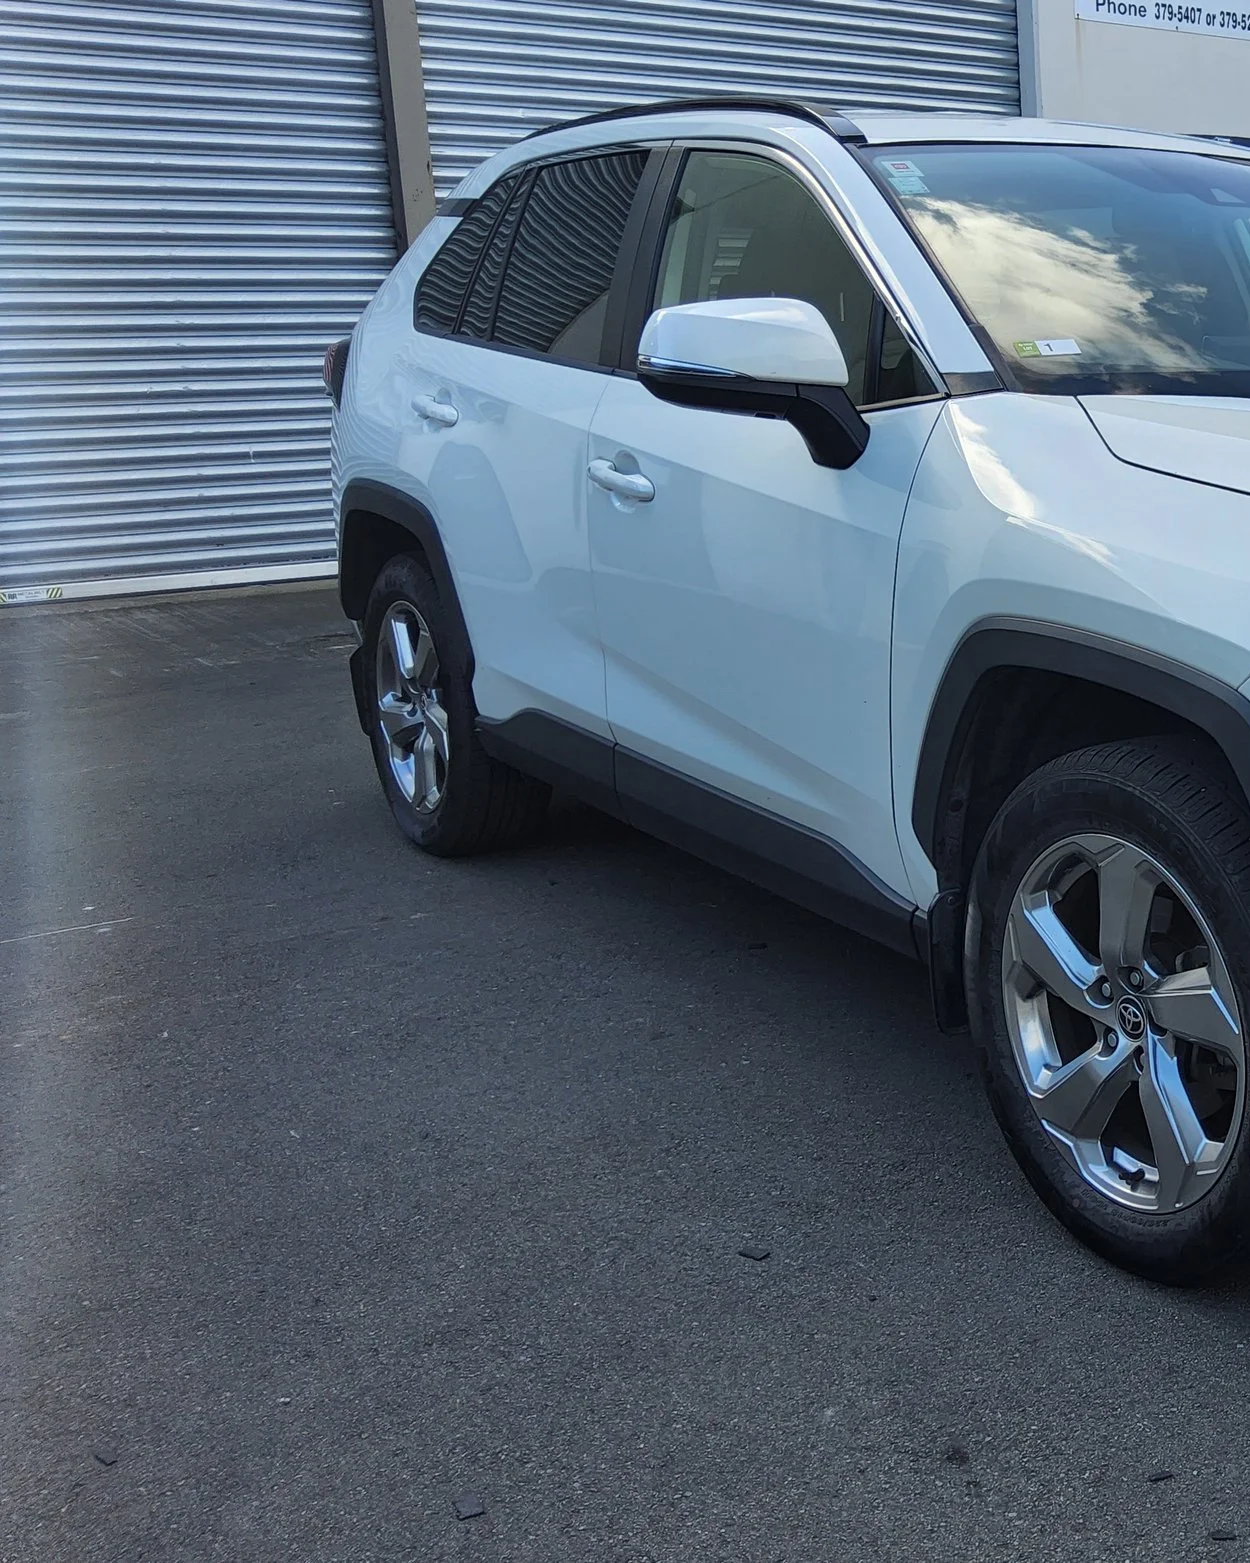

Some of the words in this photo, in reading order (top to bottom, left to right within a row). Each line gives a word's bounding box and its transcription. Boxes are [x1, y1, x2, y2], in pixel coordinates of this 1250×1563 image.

[1096, 0, 1147, 17] Phone
[1155, 2, 1202, 24] 379-5407
[1206, 12, 1216, 27] or
